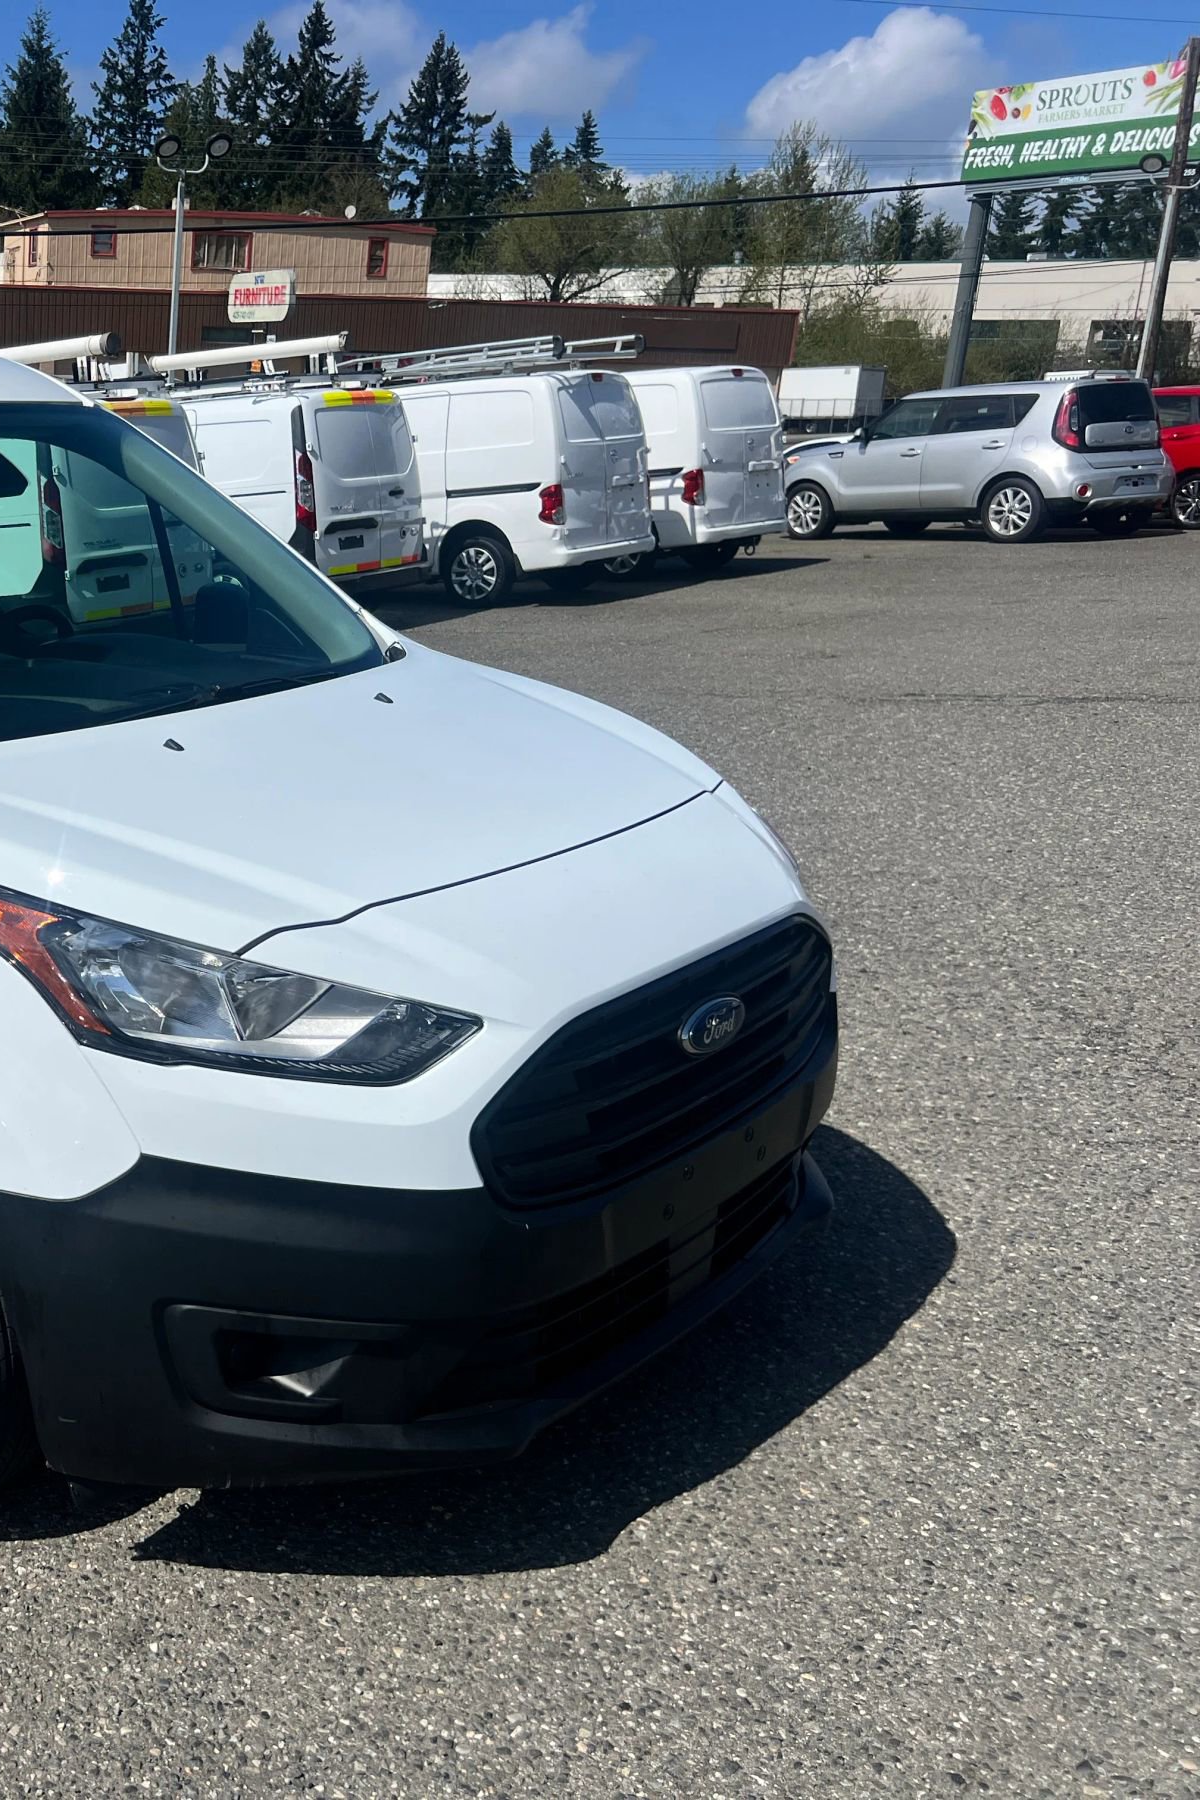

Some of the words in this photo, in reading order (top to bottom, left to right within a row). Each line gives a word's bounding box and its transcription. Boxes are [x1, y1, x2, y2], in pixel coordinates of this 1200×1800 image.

[1036, 78, 1134, 111] SPROUTS
[1038, 110, 1080, 124] FARMERS
[1082, 103, 1126, 118] MARKET
[964, 143, 1015, 169] FRESH,
[1019, 134, 1091, 163] HEALTHY
[1091, 133, 1107, 156] &
[1109, 122, 1200, 155] DELICIOS
[234, 285, 287, 307] FURNITURE
[704, 1007, 736, 1044] Ford
